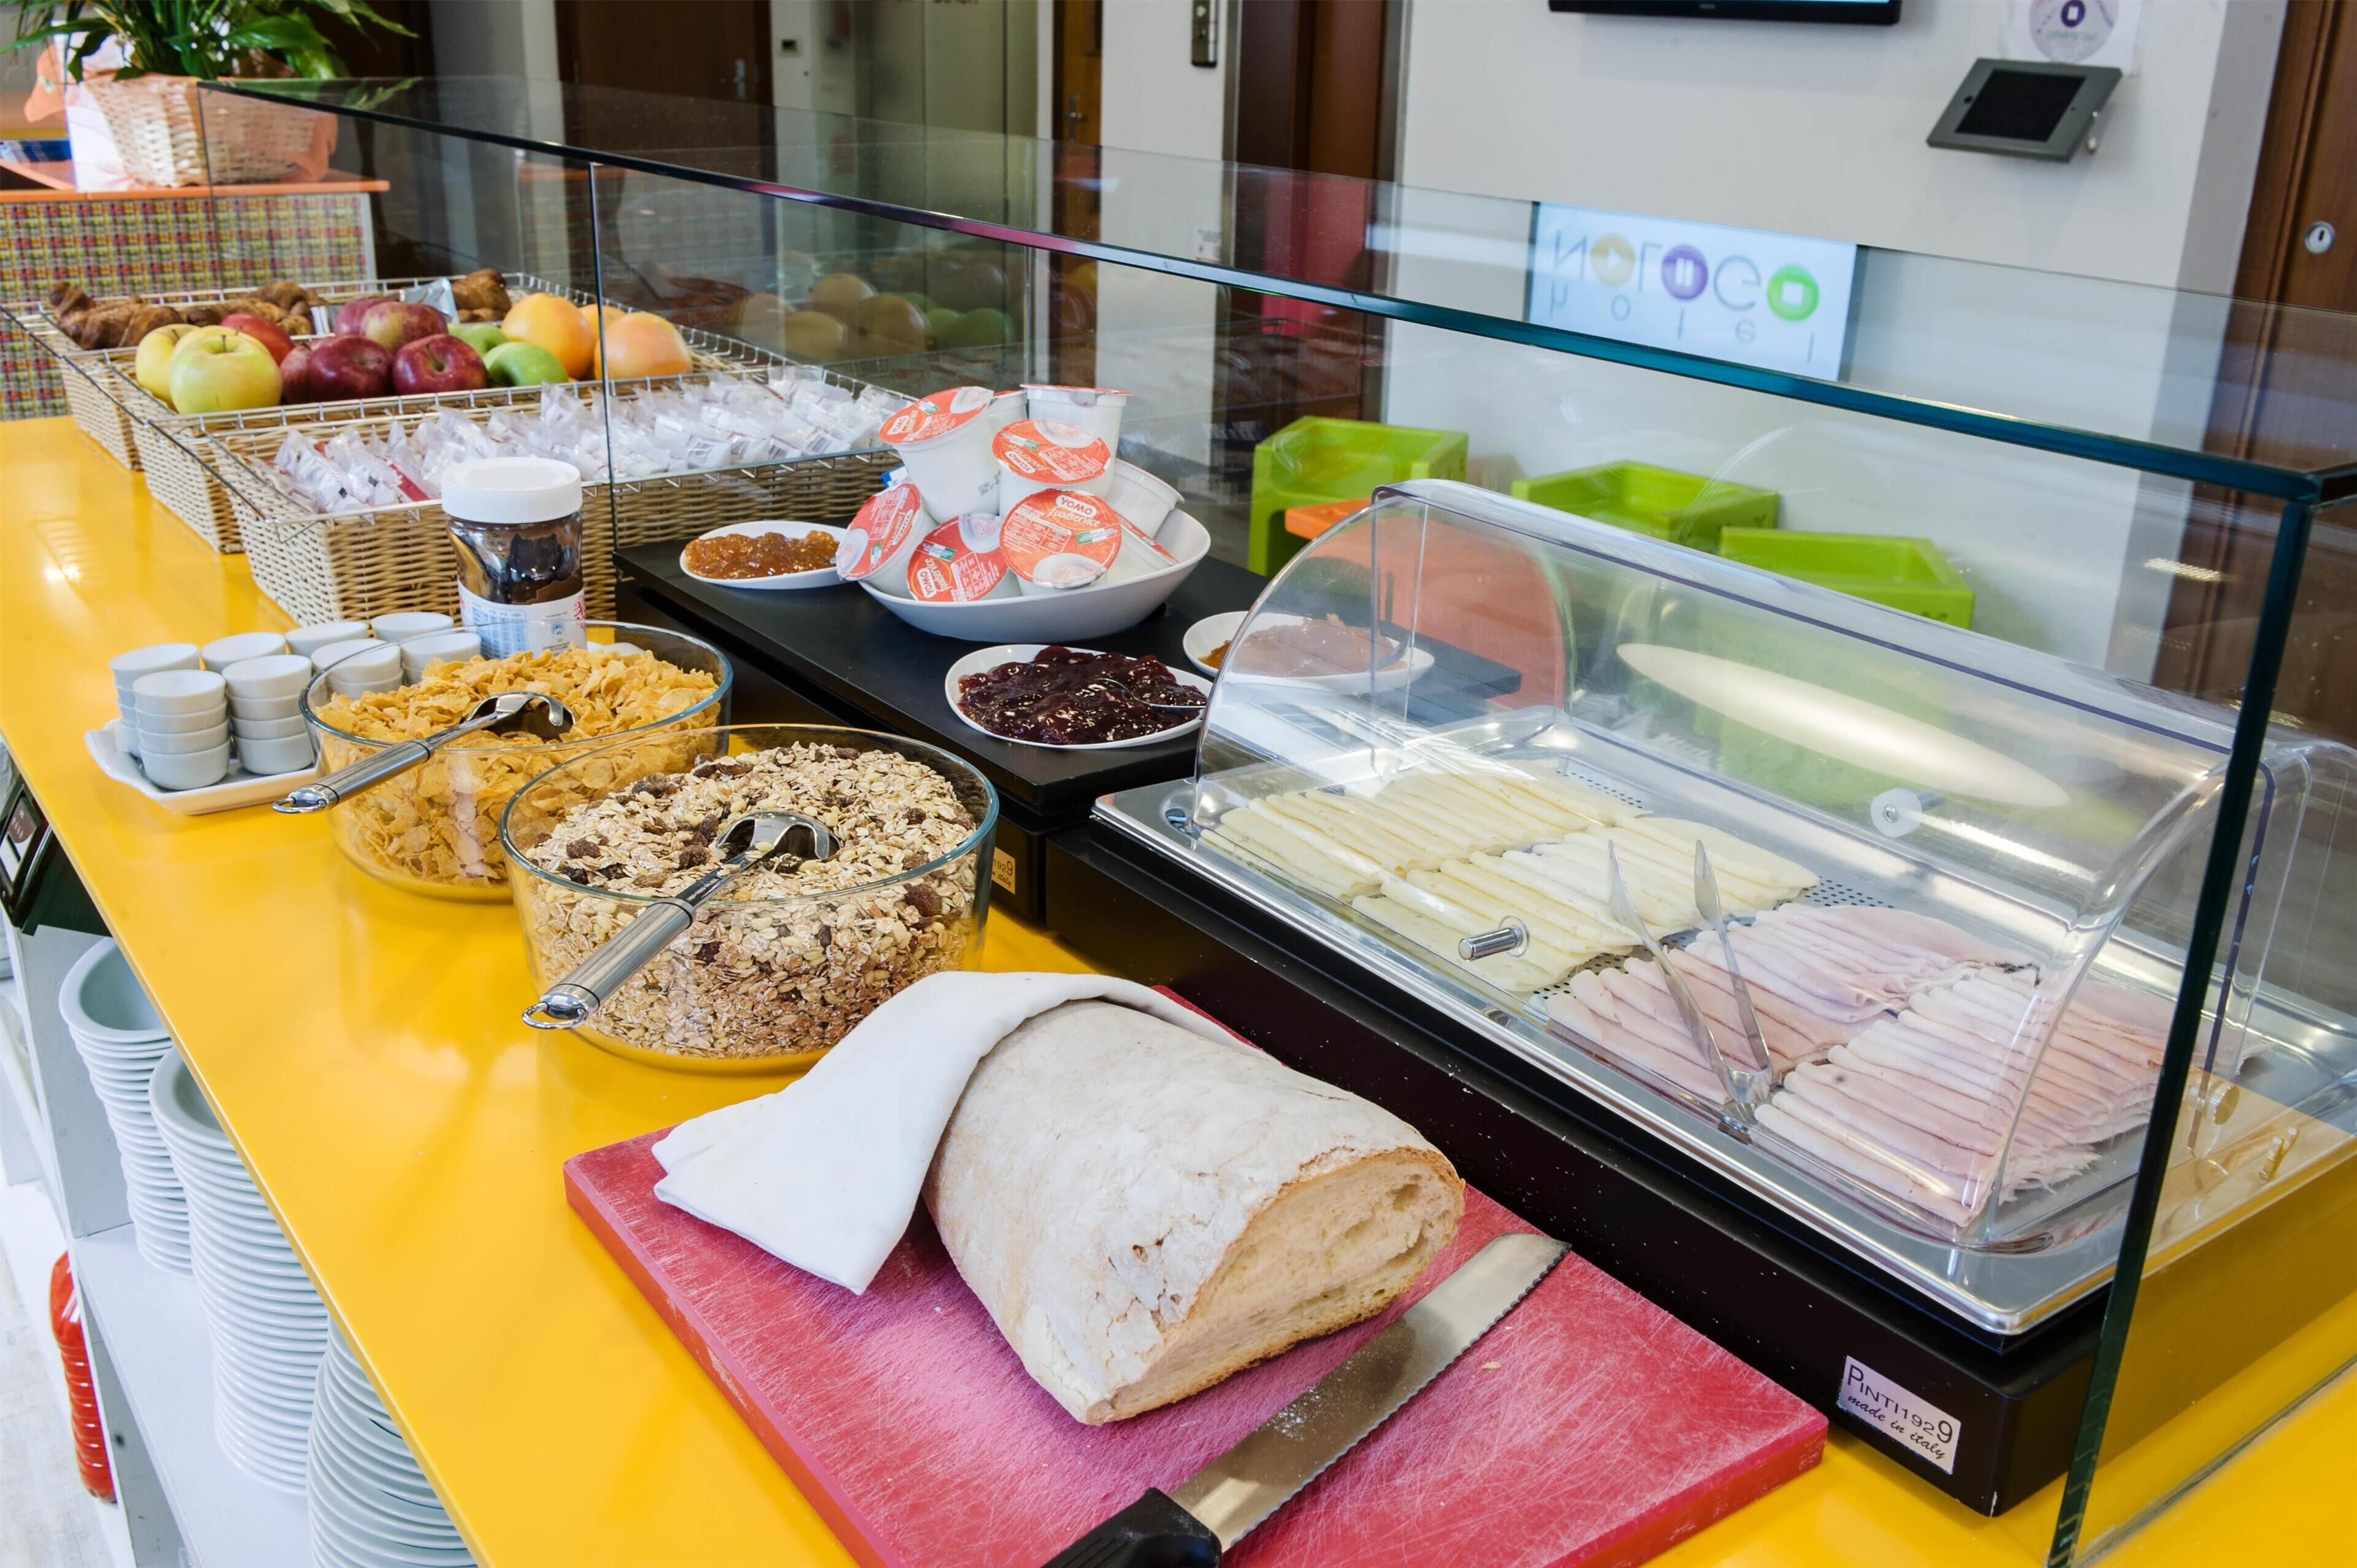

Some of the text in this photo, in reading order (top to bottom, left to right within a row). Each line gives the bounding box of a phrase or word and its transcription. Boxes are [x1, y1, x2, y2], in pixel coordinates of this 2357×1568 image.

[1008, 453, 1032, 471] YOMO
[1047, 506, 1101, 528] foodservice
[1060, 496, 1093, 516] YOMO
[920, 571, 934, 596] YOMO
[924, 557, 953, 592] foodservice
[997, 873, 1012, 888] italy
[1848, 1394, 1946, 1461] made in italy
